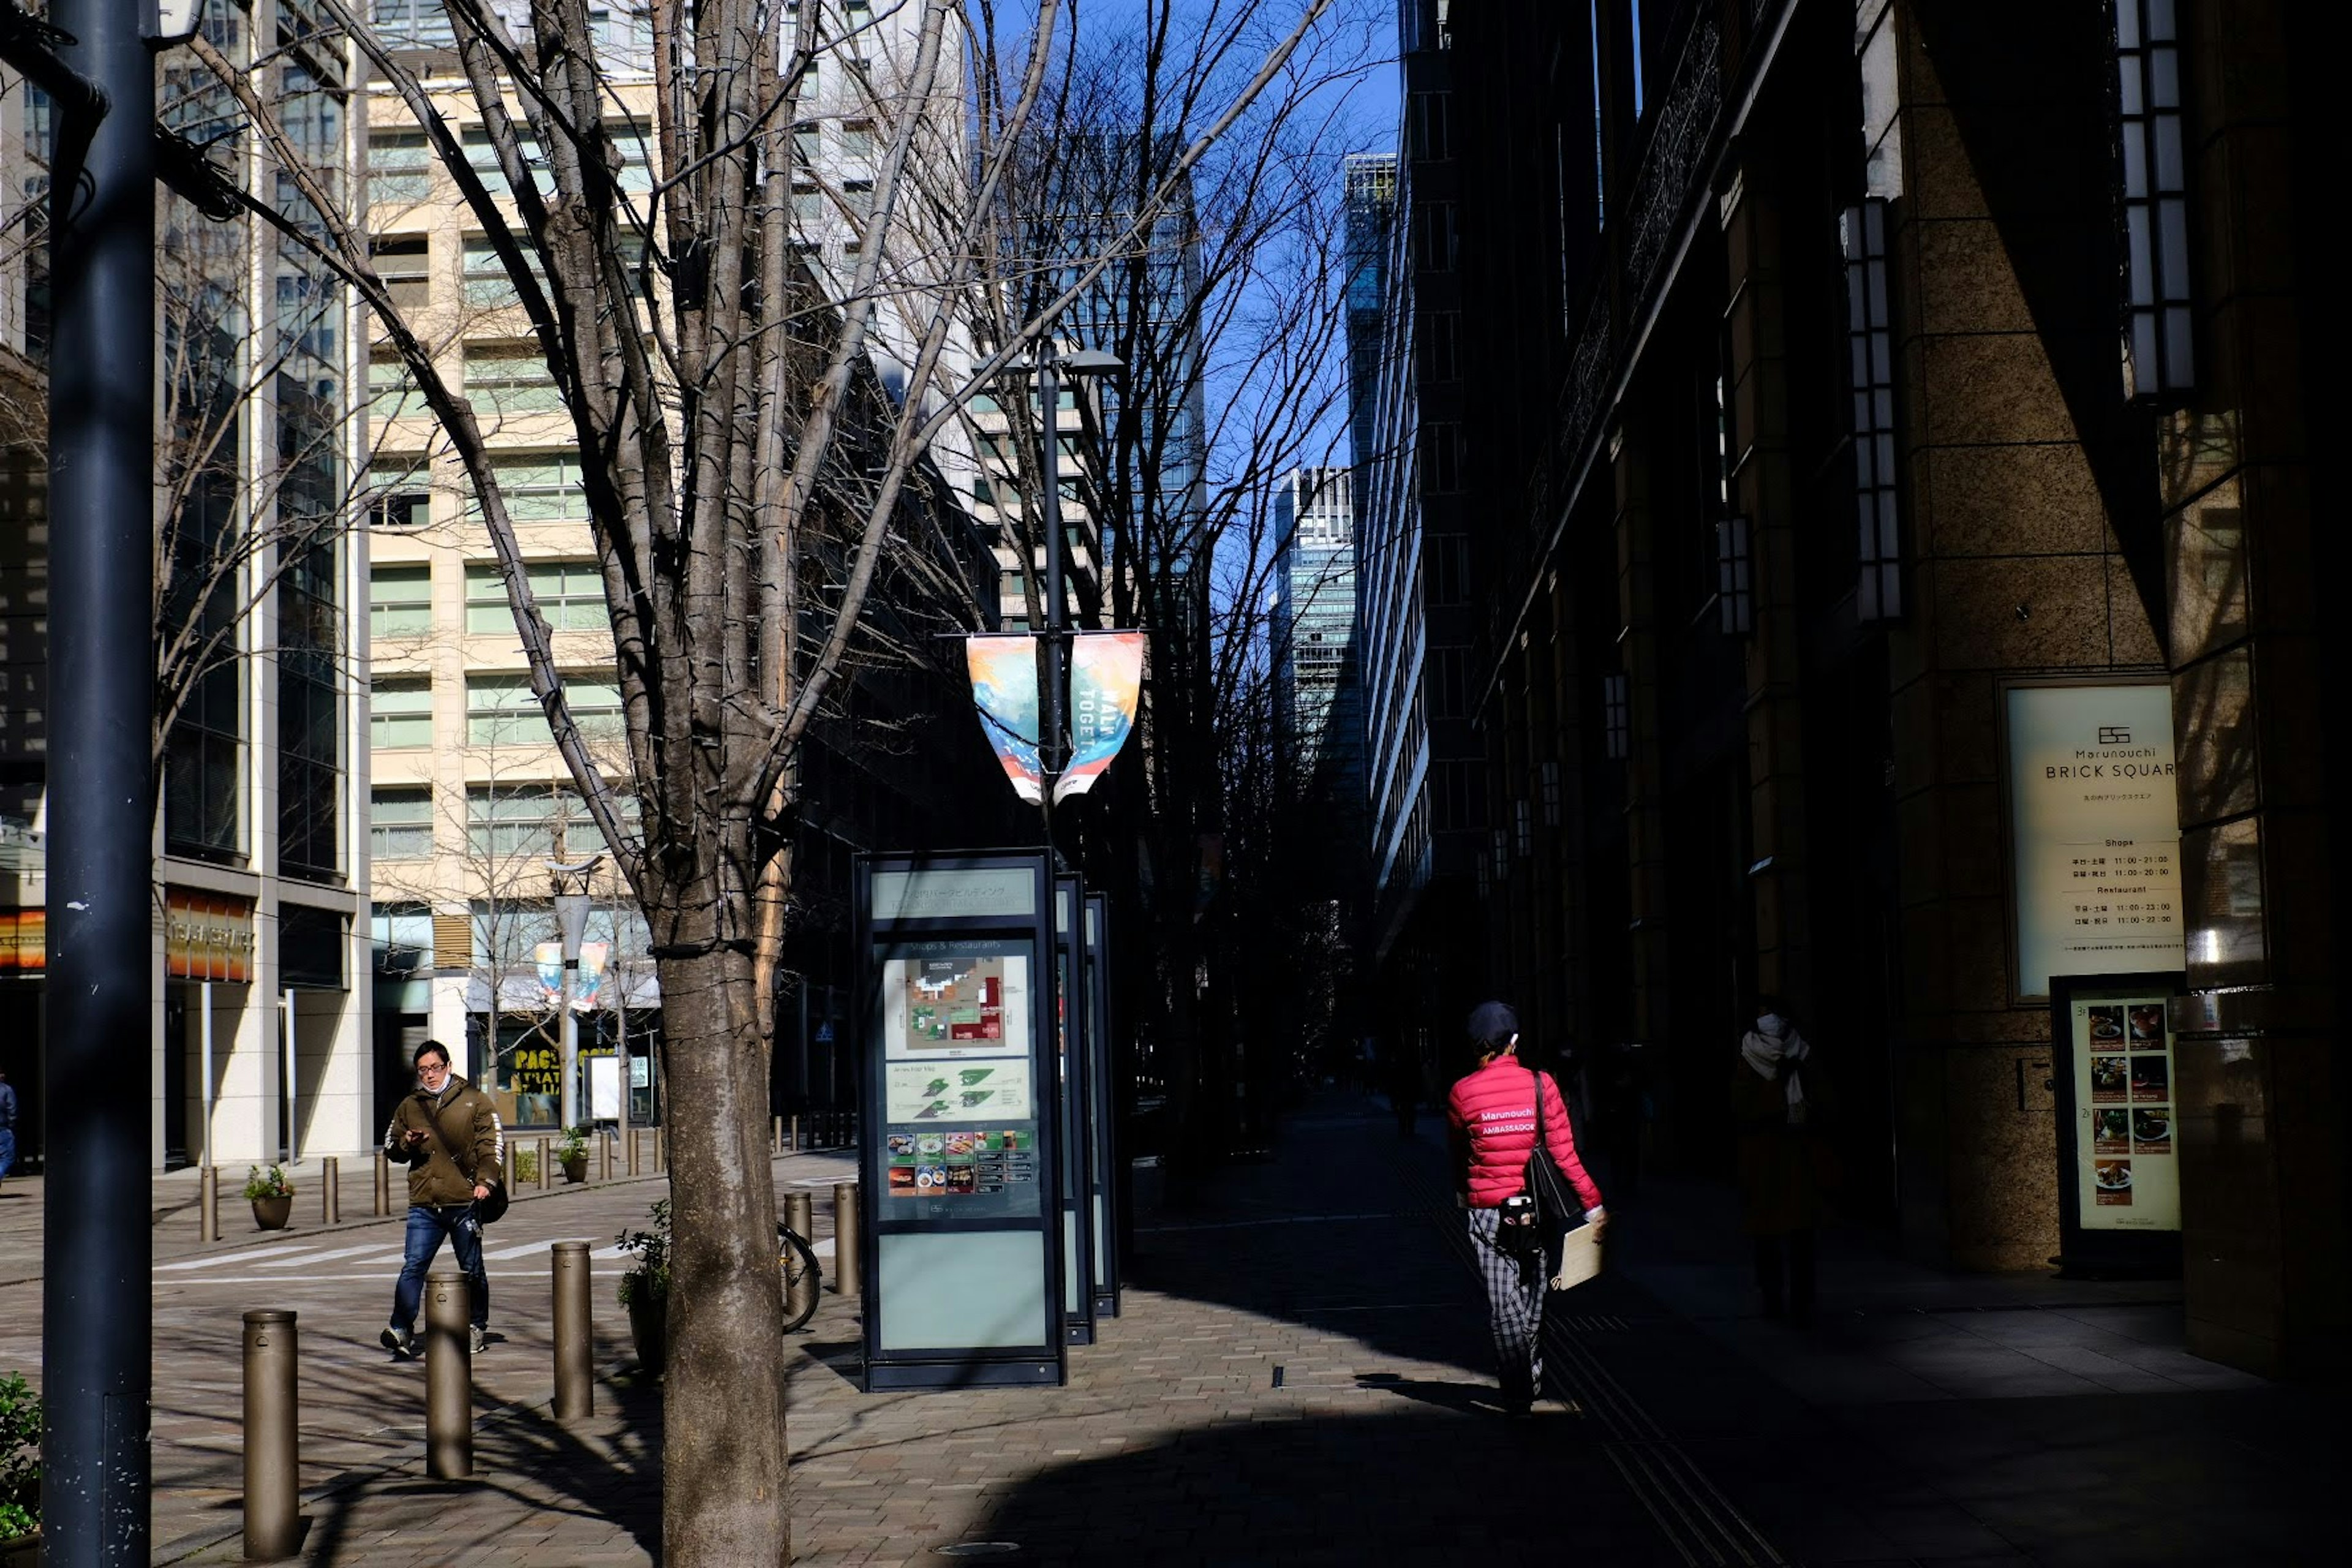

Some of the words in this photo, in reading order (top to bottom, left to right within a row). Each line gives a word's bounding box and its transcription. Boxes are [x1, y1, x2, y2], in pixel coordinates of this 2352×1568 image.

[2076, 748, 2156, 759] Marunouchi
[2046, 765, 2104, 778] BRICK
[2113, 764, 2174, 778] SQUAR
[911, 943, 937, 952] Shops
[949, 941, 1001, 949] Restaurants
[2077, 1006, 2086, 1016] 3F
[1481, 1108, 1534, 1121] Marunouchi
[1482, 1123, 1535, 1134] AMBASSADOR
